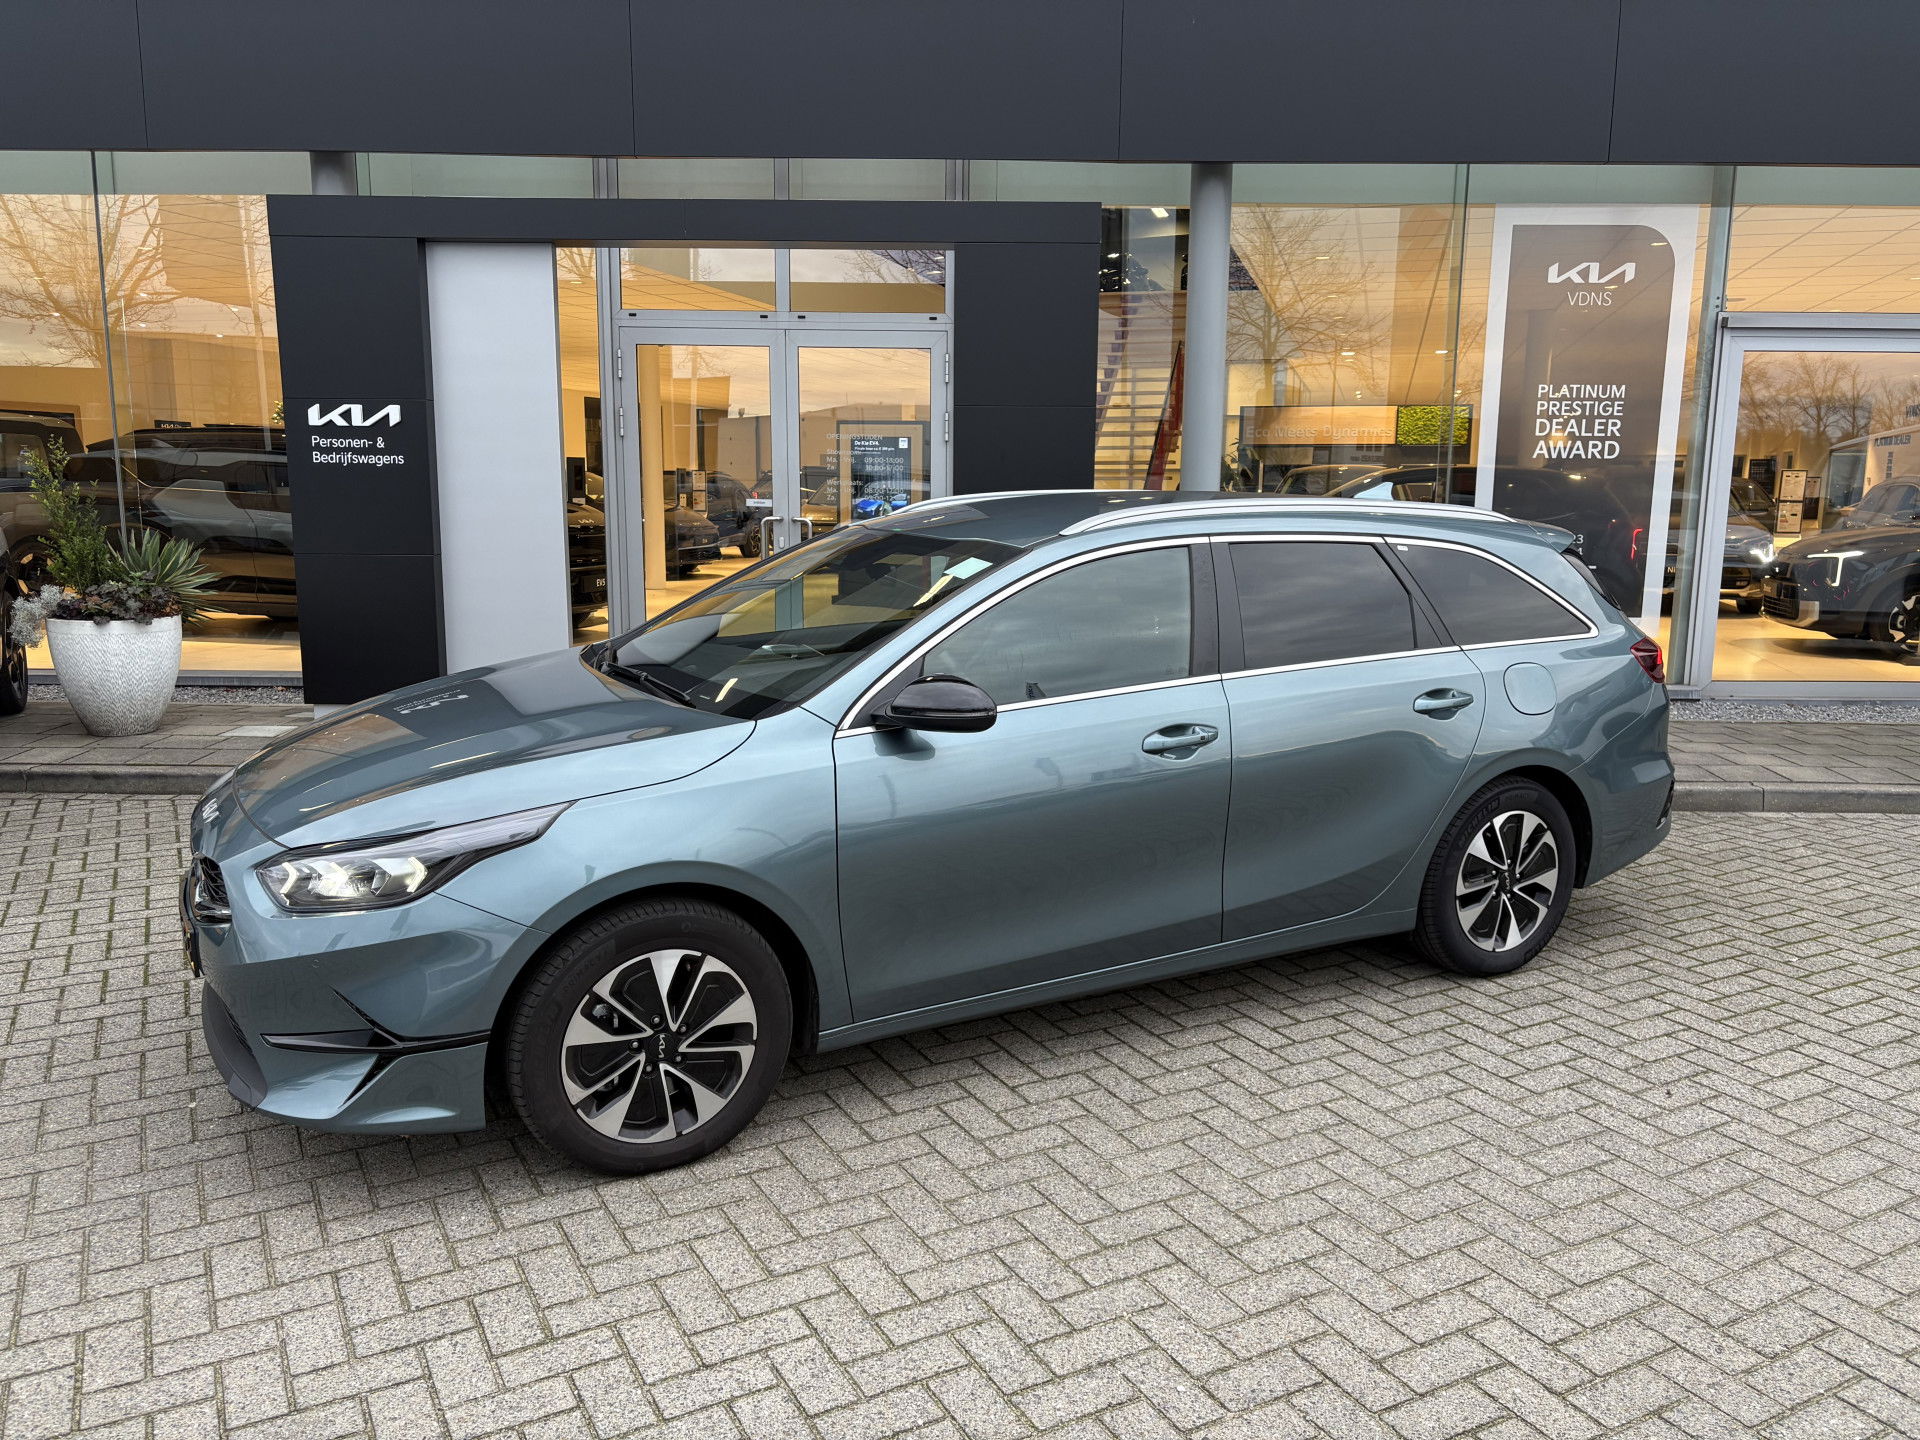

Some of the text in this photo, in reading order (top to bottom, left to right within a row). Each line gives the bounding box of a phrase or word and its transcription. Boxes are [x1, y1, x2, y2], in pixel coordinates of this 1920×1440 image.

[1547, 262, 1636, 284] KIA
[1567, 291, 1612, 306] VDNS
[1537, 384, 1626, 399] PLATINUM
[307, 403, 402, 427] KIA
[1536, 401, 1625, 416] PRESTIGE
[1246, 426, 1393, 440] Eco Meets Dynamics
[1534, 418, 1622, 437] DEALER
[311, 435, 385, 449] Personen- &
[1532, 440, 1620, 459] AWARD
[312, 451, 405, 467] Bedrijfswagens
